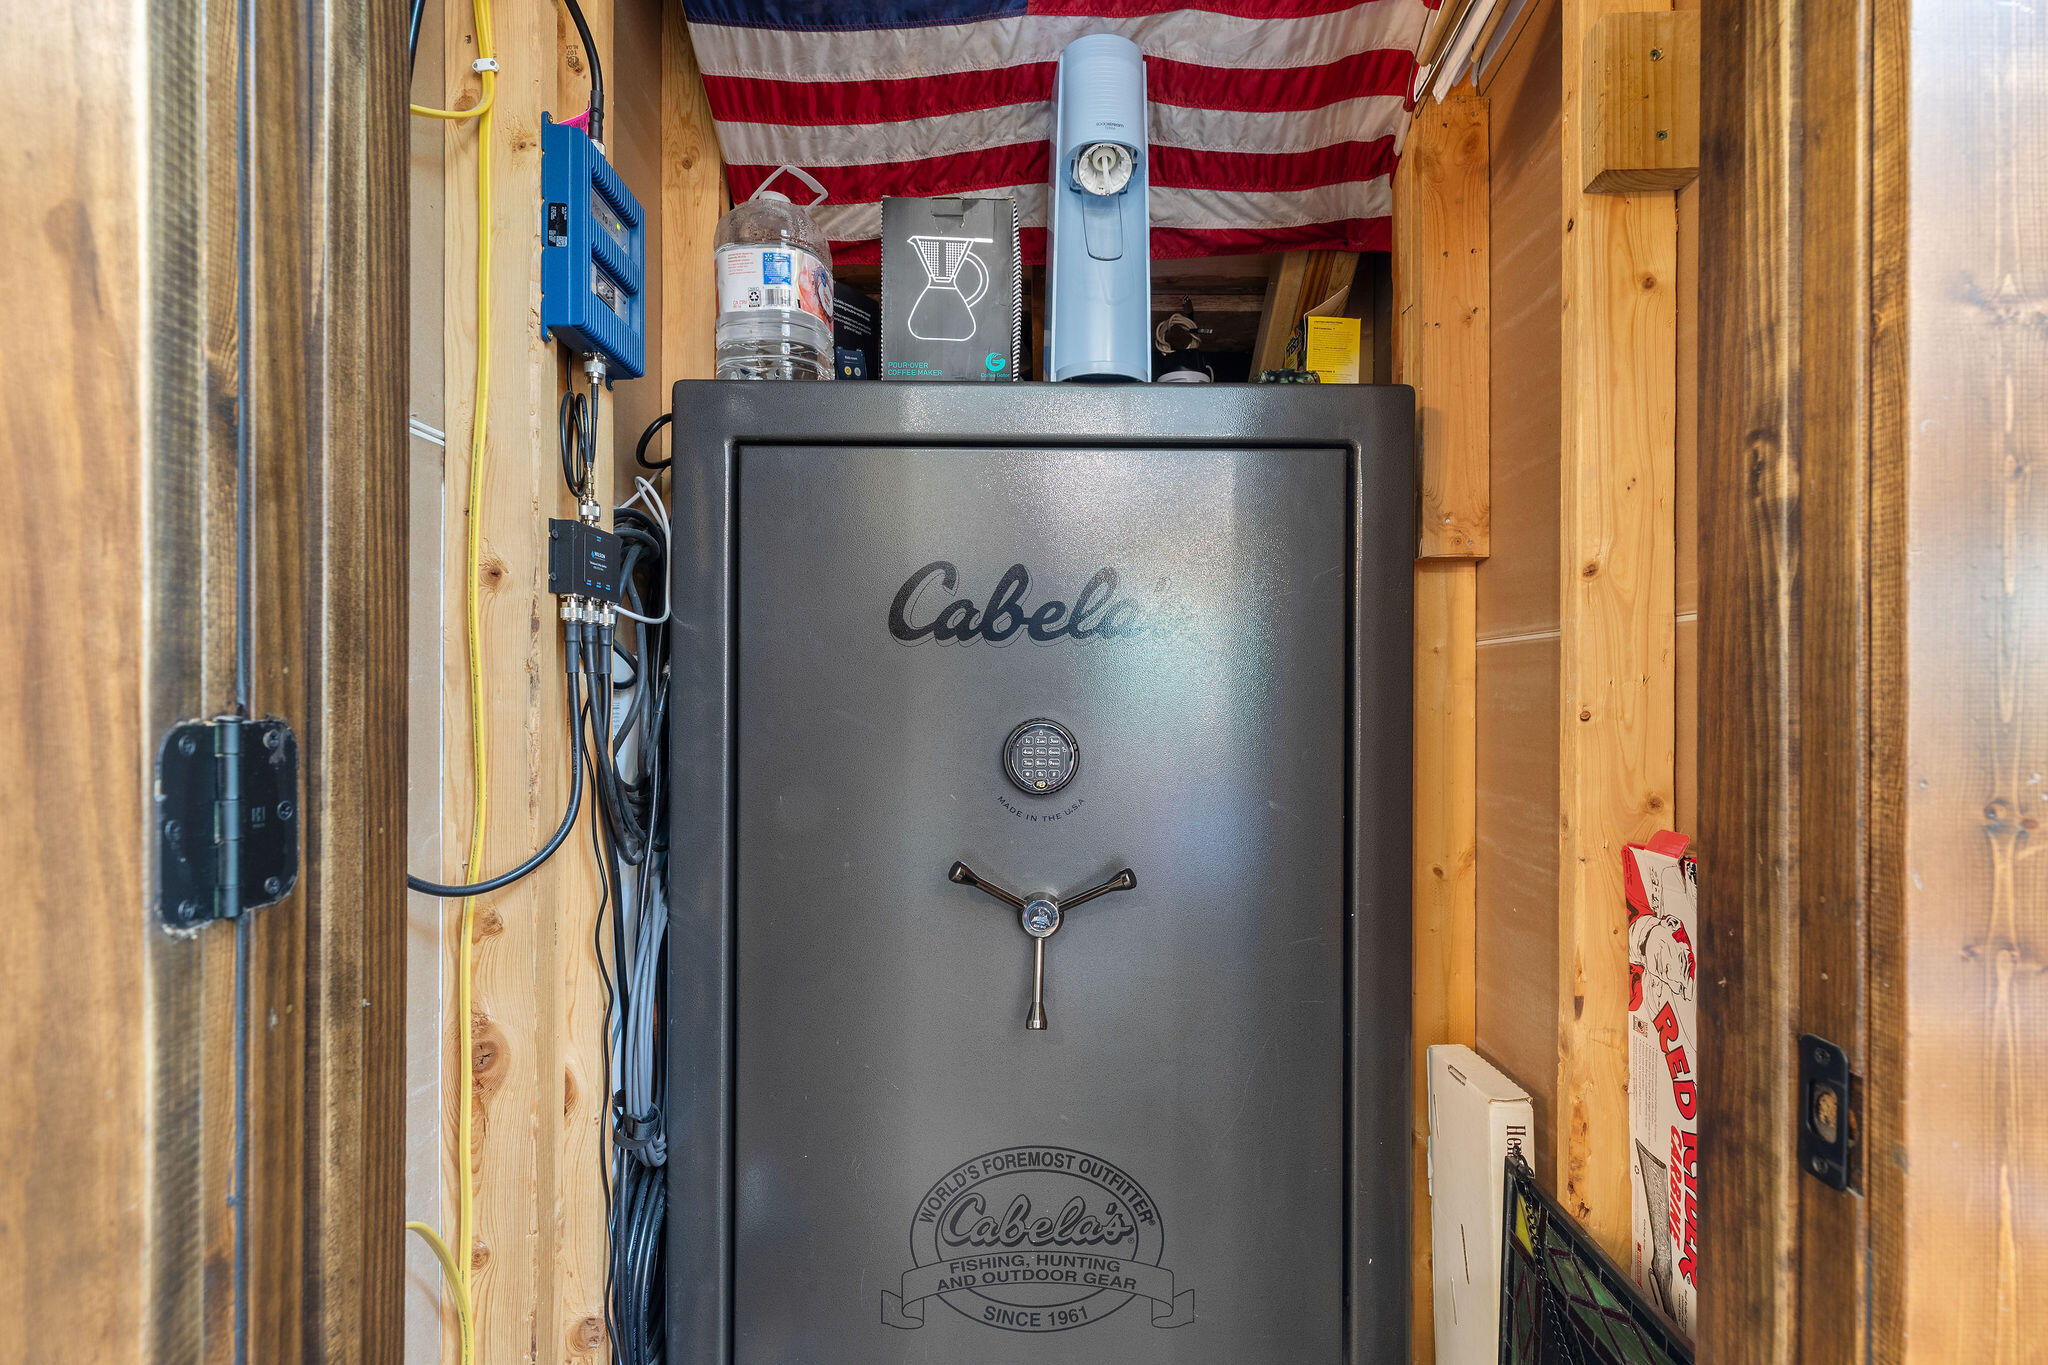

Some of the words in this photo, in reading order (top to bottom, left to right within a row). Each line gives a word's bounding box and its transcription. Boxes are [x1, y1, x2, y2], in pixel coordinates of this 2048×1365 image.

[997, 796, 1023, 817] MADE
[1042, 812, 1062, 822] THE
[1653, 1001, 1698, 1121] RED
[919, 1165, 981, 1224] WORLD'S
[982, 1151, 1075, 1175] FOREMOST
[1669, 1125, 1682, 1251] CARBINE
[941, 1193, 1135, 1247] Cabela's
[937, 1274, 976, 1291] AND
[982, 1269, 1077, 1283] OUTDOOR
[1083, 1272, 1137, 1290] GEAR
[950, 1254, 1030, 1274] FISHING,
[1036, 1254, 1121, 1272] HUNTING
[983, 1306, 1041, 1327] SINCE
[1048, 1305, 1088, 1326] 1961
